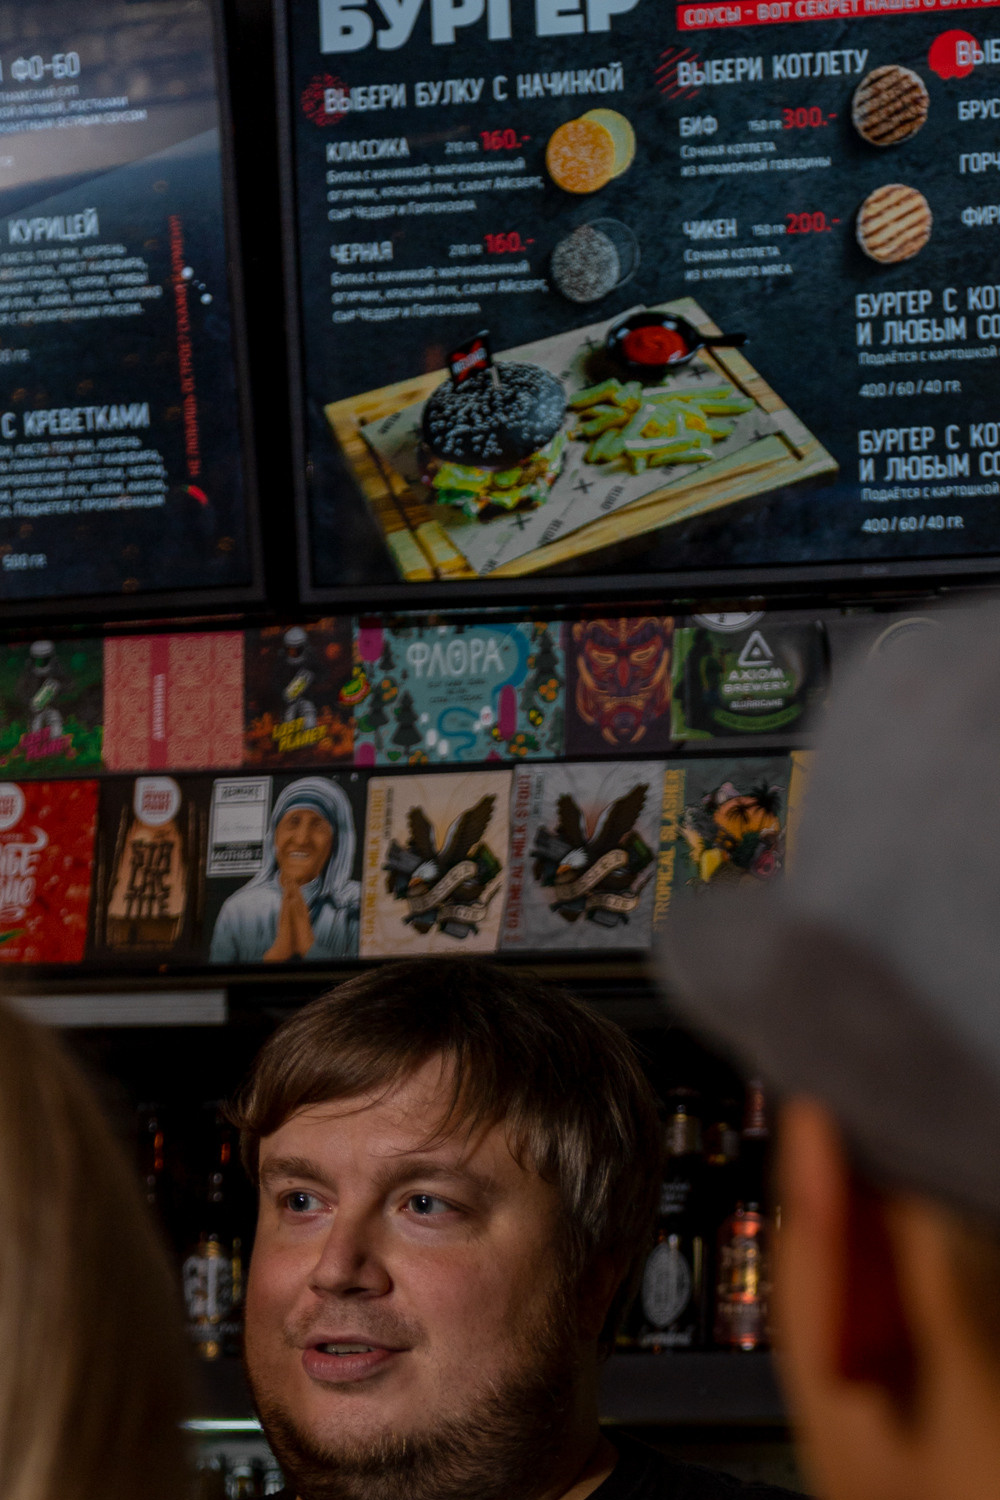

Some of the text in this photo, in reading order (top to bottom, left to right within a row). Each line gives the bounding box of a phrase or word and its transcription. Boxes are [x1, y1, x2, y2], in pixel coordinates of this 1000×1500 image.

[319, 0, 641, 54] БУРГЕР
[683, 6, 742, 26] СОУСЫ
[756, 2, 792, 20] ВОТ
[794, 0, 860, 17] СЕКРЕТ
[676, 48, 868, 87] ВЫБЕРИ КОТЛЕТУ
[324, 62, 625, 115] ВЫБЕРИ БУЛКУ С НАЧИНКОЙ
[679, 115, 718, 137] БИФ
[782, 106, 837, 129] 300.-
[8, 207, 100, 244] КУРИЦЕЙ
[682, 218, 737, 240] ЧИКЕН
[786, 211, 841, 235] 200.-
[855, 290, 933, 318] БУРГЕР
[942, 287, 958, 312] С
[856, 322, 872, 346] И
[880, 316, 967, 346] ЛЮБЫМ
[23, 402, 150, 437] КРЕВЕТКАМИ
[858, 426, 935, 455] БУРГЕР
[944, 424, 960, 450] С
[858, 458, 875, 483] И
[883, 453, 970, 482] ЛЮБЫМ
[723, 681, 790, 694] BREWERY
[728, 667, 784, 680] AXIOM
[654, 846, 677, 923] TROPICAL
